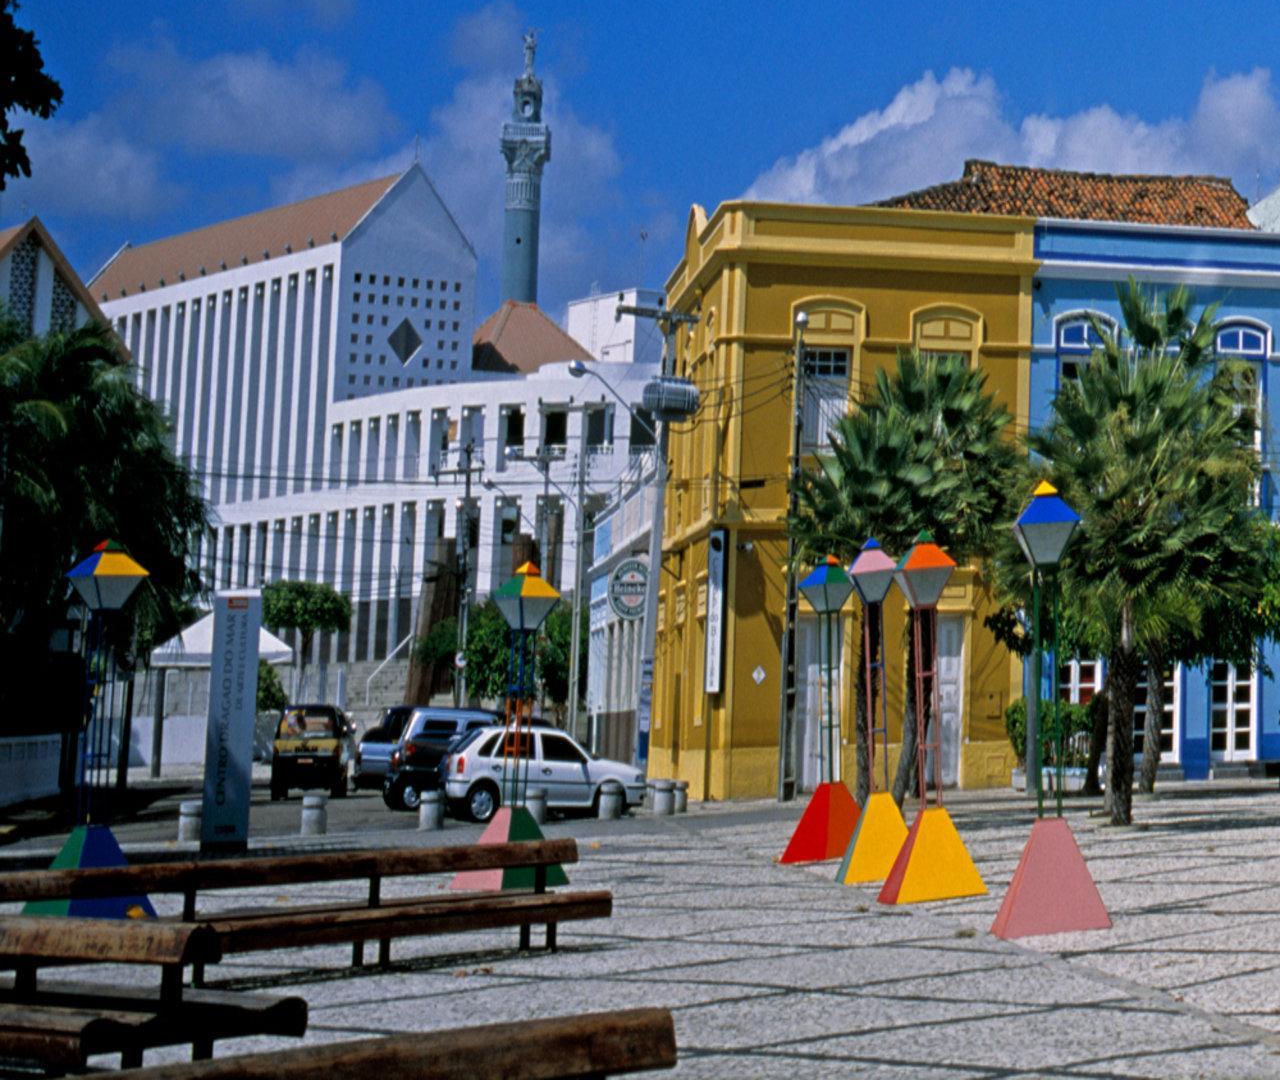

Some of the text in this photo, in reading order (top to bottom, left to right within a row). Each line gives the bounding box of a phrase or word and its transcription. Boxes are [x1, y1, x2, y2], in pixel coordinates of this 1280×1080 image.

[612, 582, 647, 594] Heineke
[225, 613, 236, 646] MAR
[223, 649, 234, 674] DO
